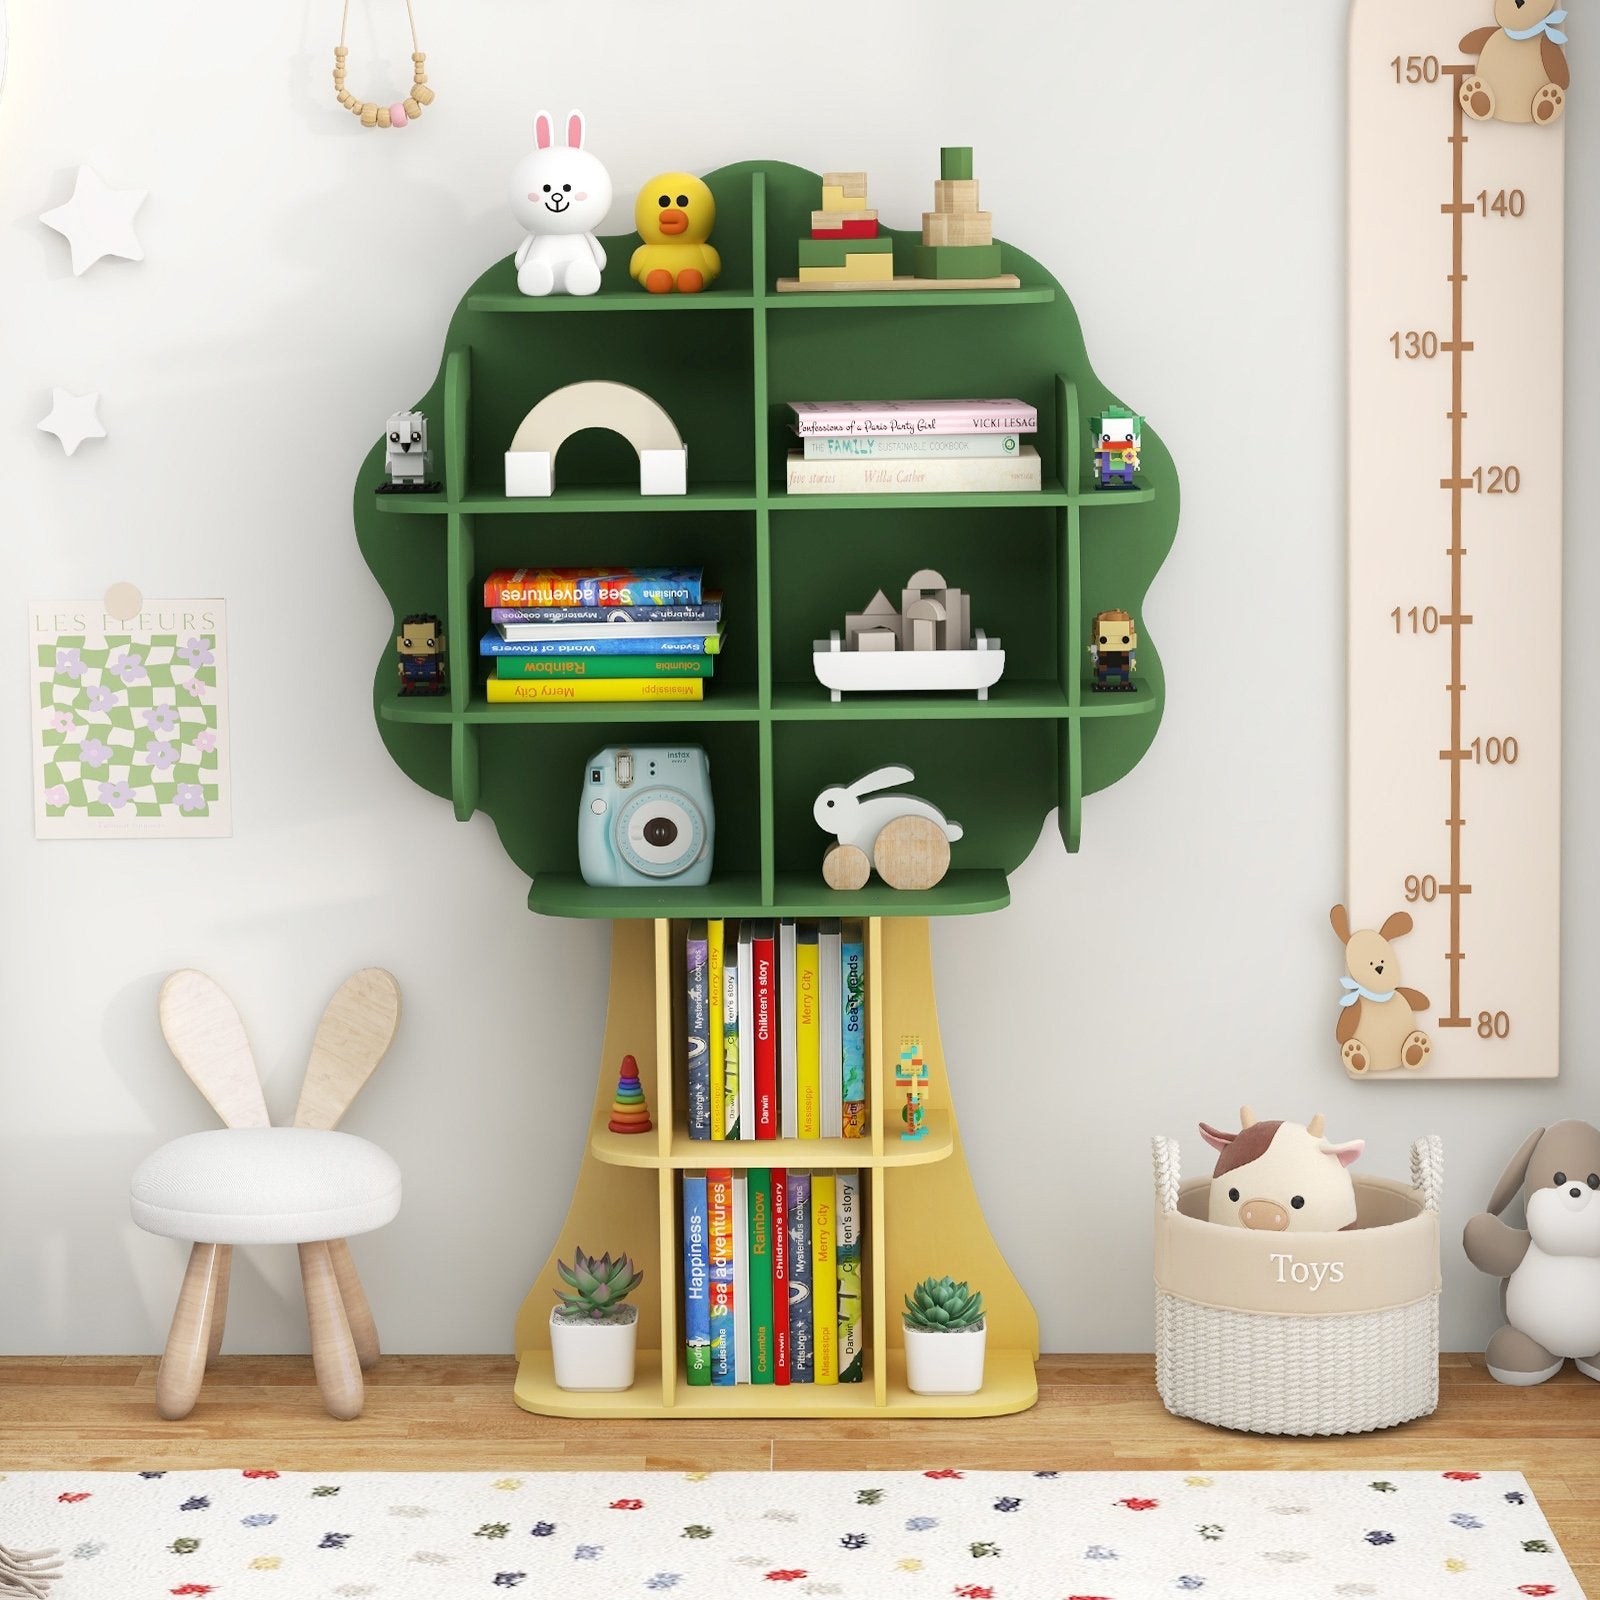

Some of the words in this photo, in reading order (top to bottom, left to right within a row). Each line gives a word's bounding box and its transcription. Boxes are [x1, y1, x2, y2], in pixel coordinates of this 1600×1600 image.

[1390, 56, 1439, 84] 150
[1477, 189, 1525, 217] 140
[1390, 331, 1438, 359] 130
[798, 420, 843, 434] Confessions
[844, 420, 855, 434] of
[864, 421, 887, 434] Paris
[890, 420, 915, 434] Party
[917, 419, 936, 432] Girl
[973, 418, 999, 428] VICKI
[812, 443, 824, 452] THE
[828, 438, 874, 454] FAMILY
[878, 442, 927, 450] SUSTAINABLE
[929, 442, 968, 450] COOKBOOK
[1472, 466, 1520, 494] 120
[502, 589, 593, 603] adventures
[599, 588, 632, 603] Sea
[643, 589, 689, 600] Louisiana
[35, 614, 86, 632] LES
[544, 612, 598, 620] Mysterious
[1391, 606, 1438, 634] 110
[660, 643, 700, 651] Sydney
[524, 662, 586, 674] Rainbow
[656, 662, 700, 670] Columbia
[515, 686, 537, 698] City
[542, 686, 574, 697] Merry
[642, 686, 694, 694] Mississippi
[1471, 736, 1518, 765] 100
[1404, 875, 1437, 902] 90
[712, 948, 720, 970] City
[759, 960, 769, 986] story
[712, 974, 720, 1006] Merry
[727, 976, 735, 997] story
[802, 970, 812, 990] City
[758, 988, 768, 1040] Children's
[802, 994, 813, 1024] Merry
[848, 1008, 858, 1032] Sea
[1477, 1012, 1510, 1039] 80
[761, 1095, 769, 1124] Darwin
[805, 1086, 813, 1132] Mississippi
[776, 1182, 784, 1214] story
[842, 1184, 853, 1212] story
[754, 1192, 765, 1254] Rainbow
[817, 1204, 828, 1226] City
[713, 1184, 726, 1278] adventures
[688, 1215, 705, 1299] Happiness
[796, 1224, 806, 1272] Mysterious
[818, 1230, 828, 1262] Merry
[1270, 1254, 1344, 1292] Toys
[714, 1284, 727, 1316] Sea
[718, 1328, 727, 1374] Louisiana
[758, 1326, 766, 1372] Columbia
[822, 1328, 830, 1376] Mississippi
[845, 1324, 854, 1354] Darwin
